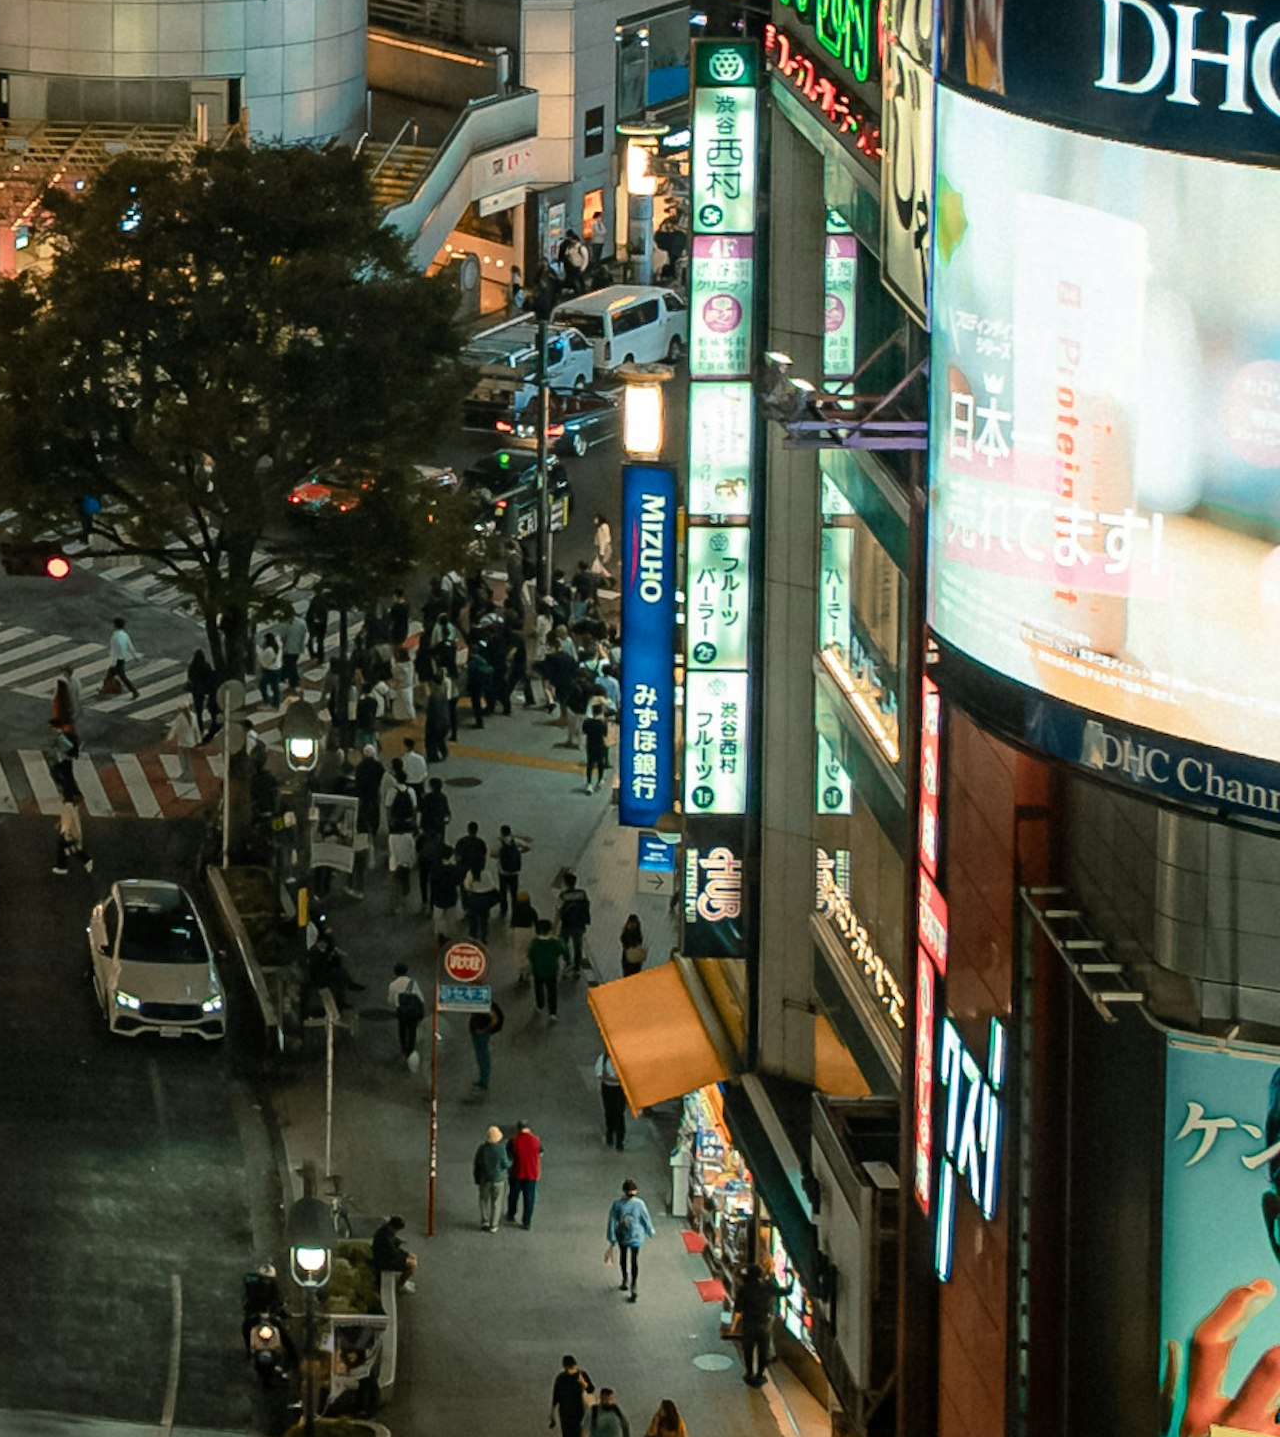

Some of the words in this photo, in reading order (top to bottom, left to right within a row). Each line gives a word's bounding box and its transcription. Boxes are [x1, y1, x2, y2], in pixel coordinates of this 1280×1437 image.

[640, 494, 666, 603] MIZUHO
[696, 568, 716, 637] パーラー
[721, 557, 739, 626] フルーツ
[632, 684, 658, 800] みずほ銀行
[694, 711, 715, 782] フルーツ
[719, 702, 738, 774] 渋谷西村
[697, 846, 742, 922] HUB
